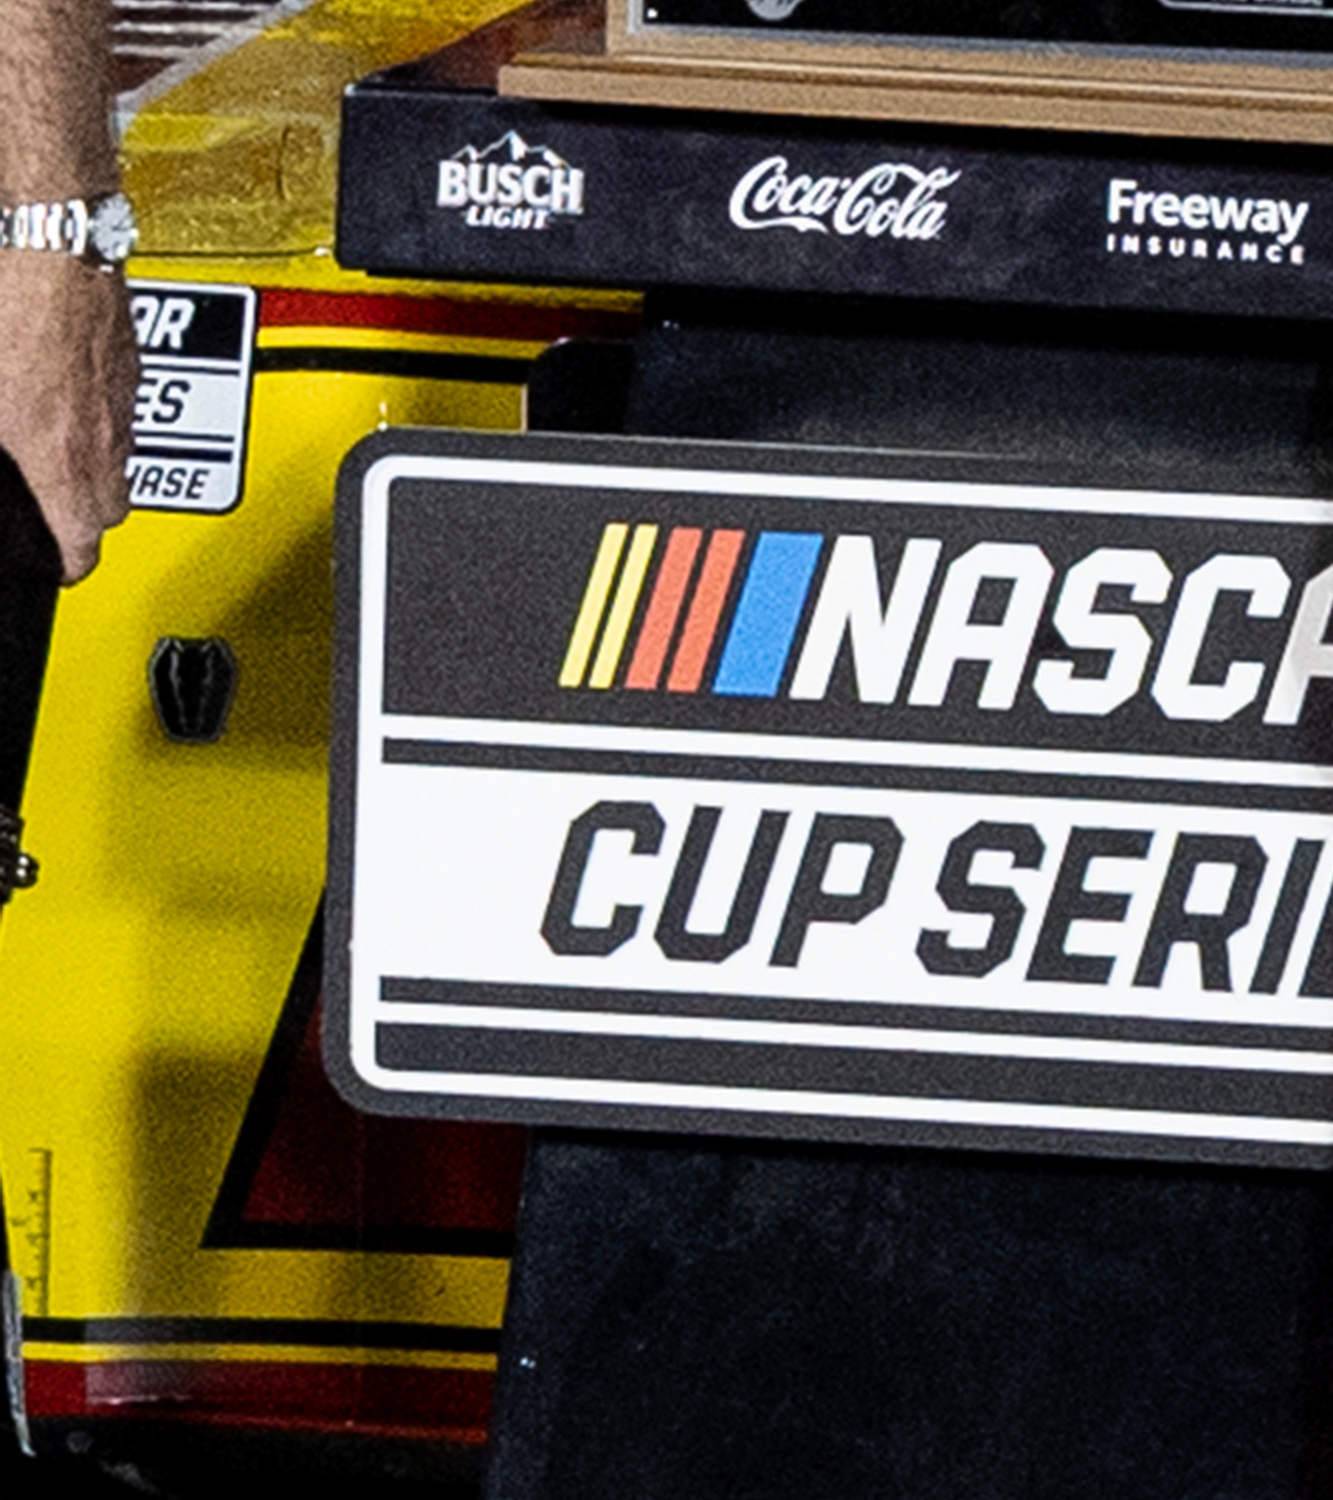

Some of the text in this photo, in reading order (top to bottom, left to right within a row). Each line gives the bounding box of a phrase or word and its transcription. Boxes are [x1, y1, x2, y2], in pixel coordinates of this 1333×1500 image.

[437, 156, 584, 217] BUSCH
[465, 207, 551, 230] LIGHT
[729, 155, 962, 243] Coca-Cola
[1107, 177, 1311, 245] Freeway
[1107, 232, 1306, 267] INSURANCE
[538, 799, 909, 970] CUP
